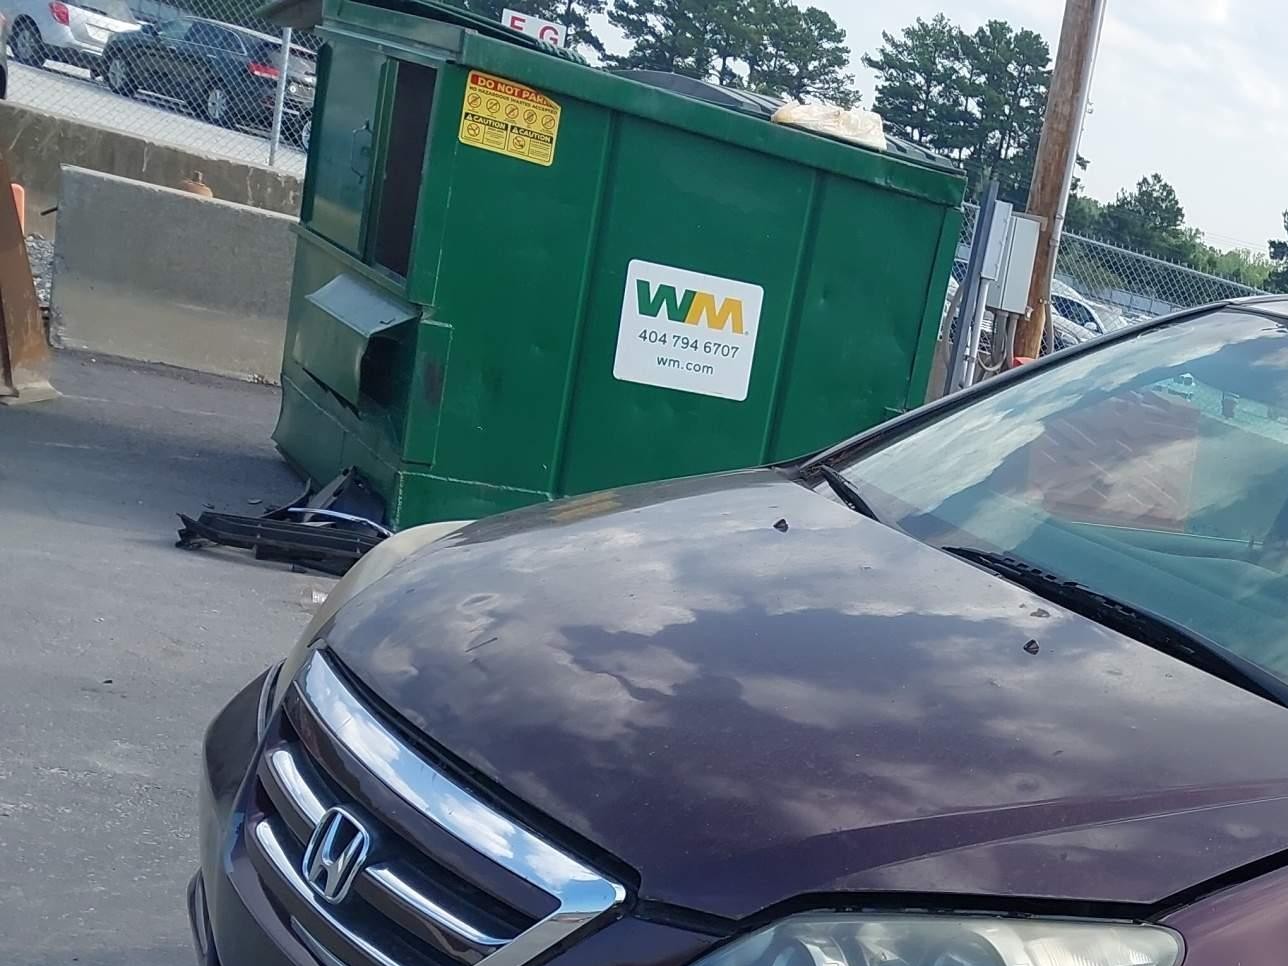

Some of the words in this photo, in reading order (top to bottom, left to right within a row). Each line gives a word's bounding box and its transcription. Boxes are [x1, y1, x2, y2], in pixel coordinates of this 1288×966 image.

[477, 76, 495, 89] DO
[497, 84, 520, 98] NOT
[472, 116, 506, 130] CAUTION
[517, 128, 551, 143] CAUTION
[636, 279, 744, 335] WM
[638, 329, 667, 345] 404
[672, 335, 698, 351] 794
[703, 341, 739, 358] 6707
[657, 356, 714, 375] wm.com
